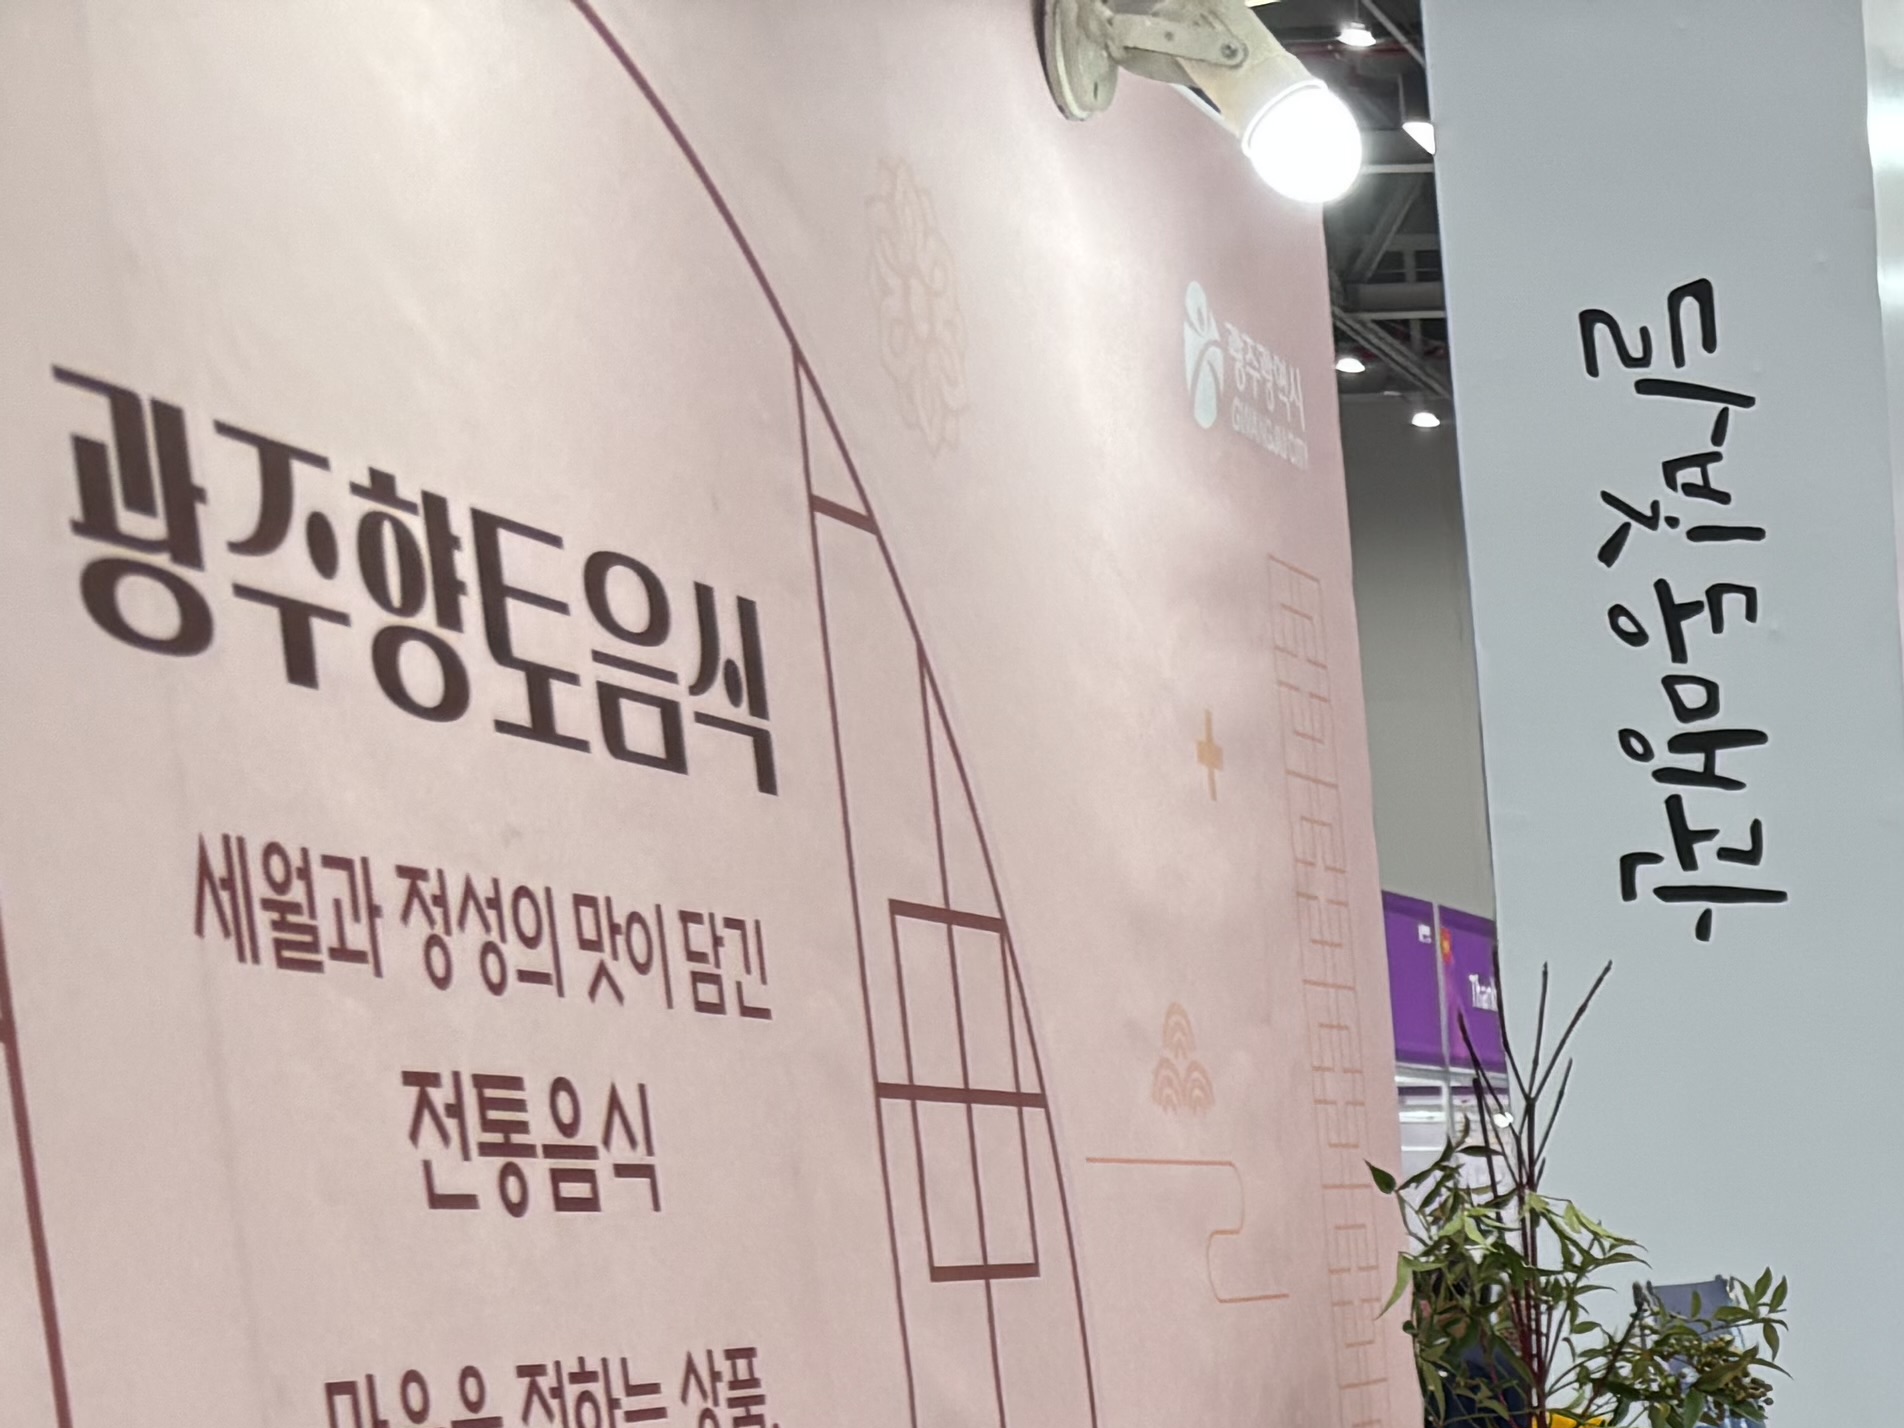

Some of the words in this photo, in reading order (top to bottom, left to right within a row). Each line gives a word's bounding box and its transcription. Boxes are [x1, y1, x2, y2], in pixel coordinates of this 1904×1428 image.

[51, 364, 779, 796] 광주향도음식
[194, 832, 384, 980] 세월과
[395, 862, 565, 999] 정성의
[571, 891, 670, 1010] 맛이
[678, 908, 773, 1020] 담긴
[400, 1067, 663, 1219] 전통음식
